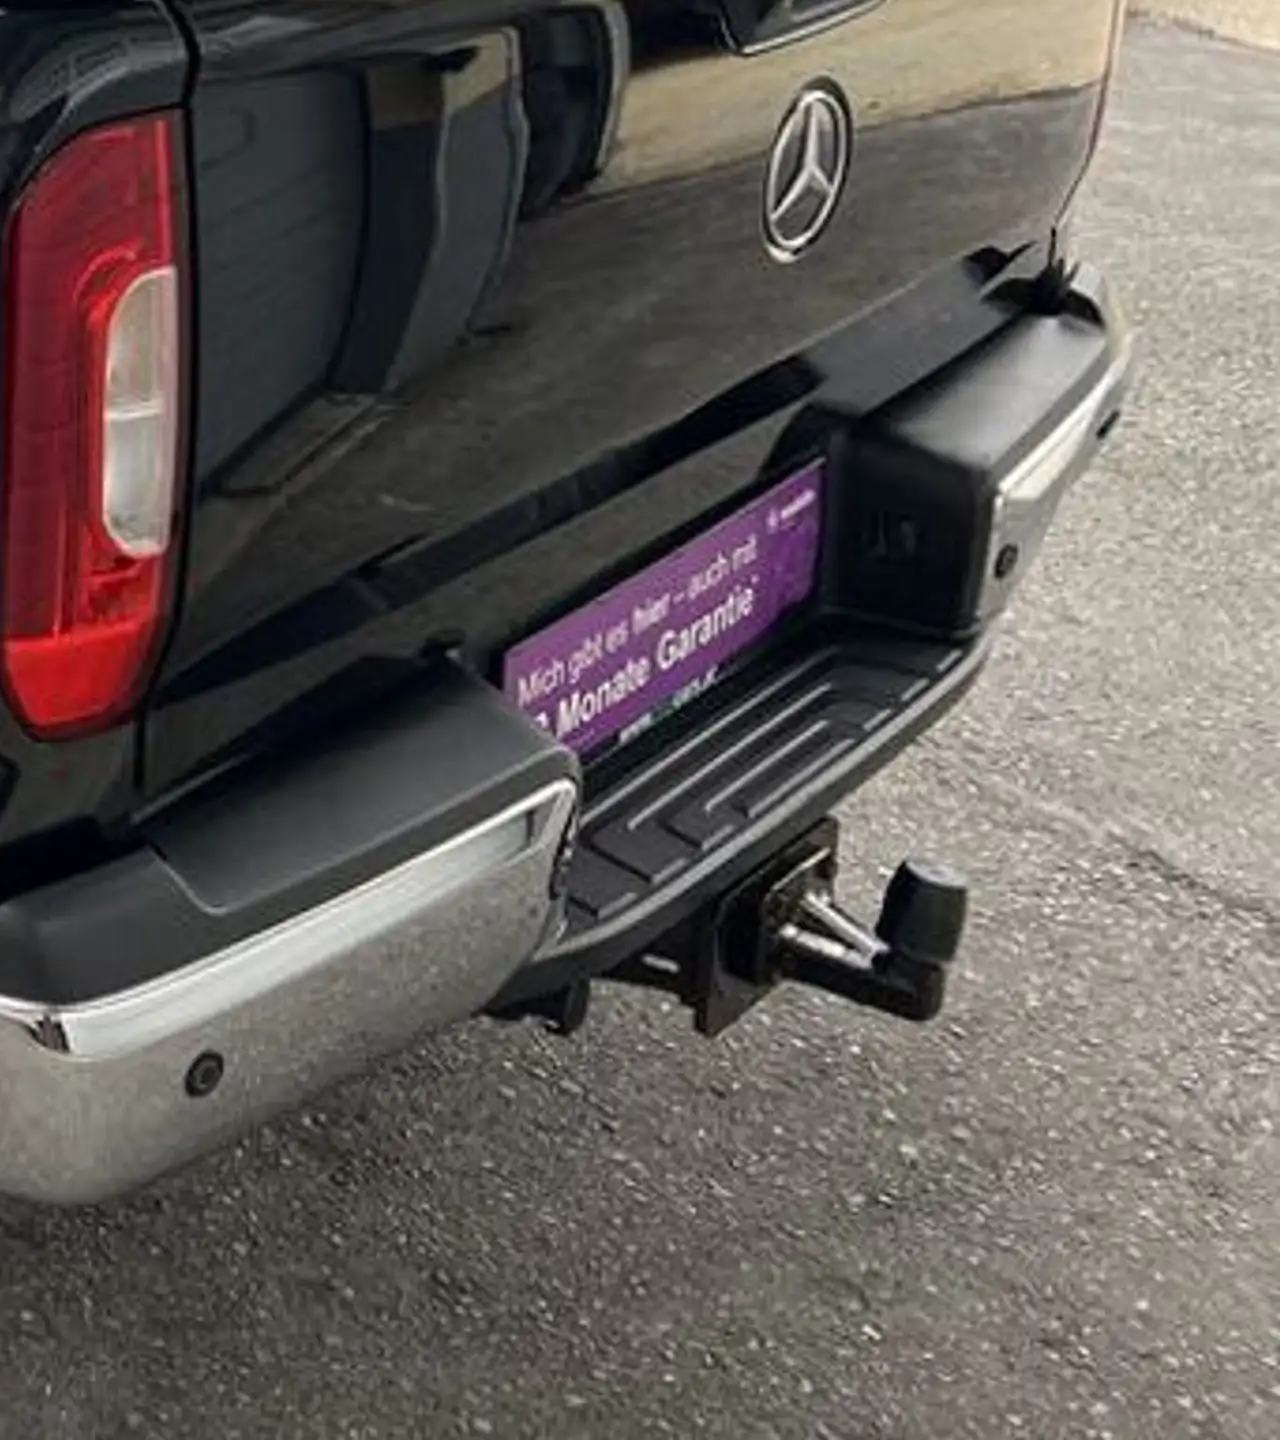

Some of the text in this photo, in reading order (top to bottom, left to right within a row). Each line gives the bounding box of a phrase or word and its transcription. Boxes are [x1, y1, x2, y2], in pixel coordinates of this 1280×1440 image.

[516, 654, 566, 710] Mich
[567, 636, 605, 684] gibt
[605, 620, 630, 653] es
[631, 591, 670, 635] hier
[687, 551, 730, 601] auch
[731, 533, 758, 570] mit
[555, 654, 651, 740] Monate
